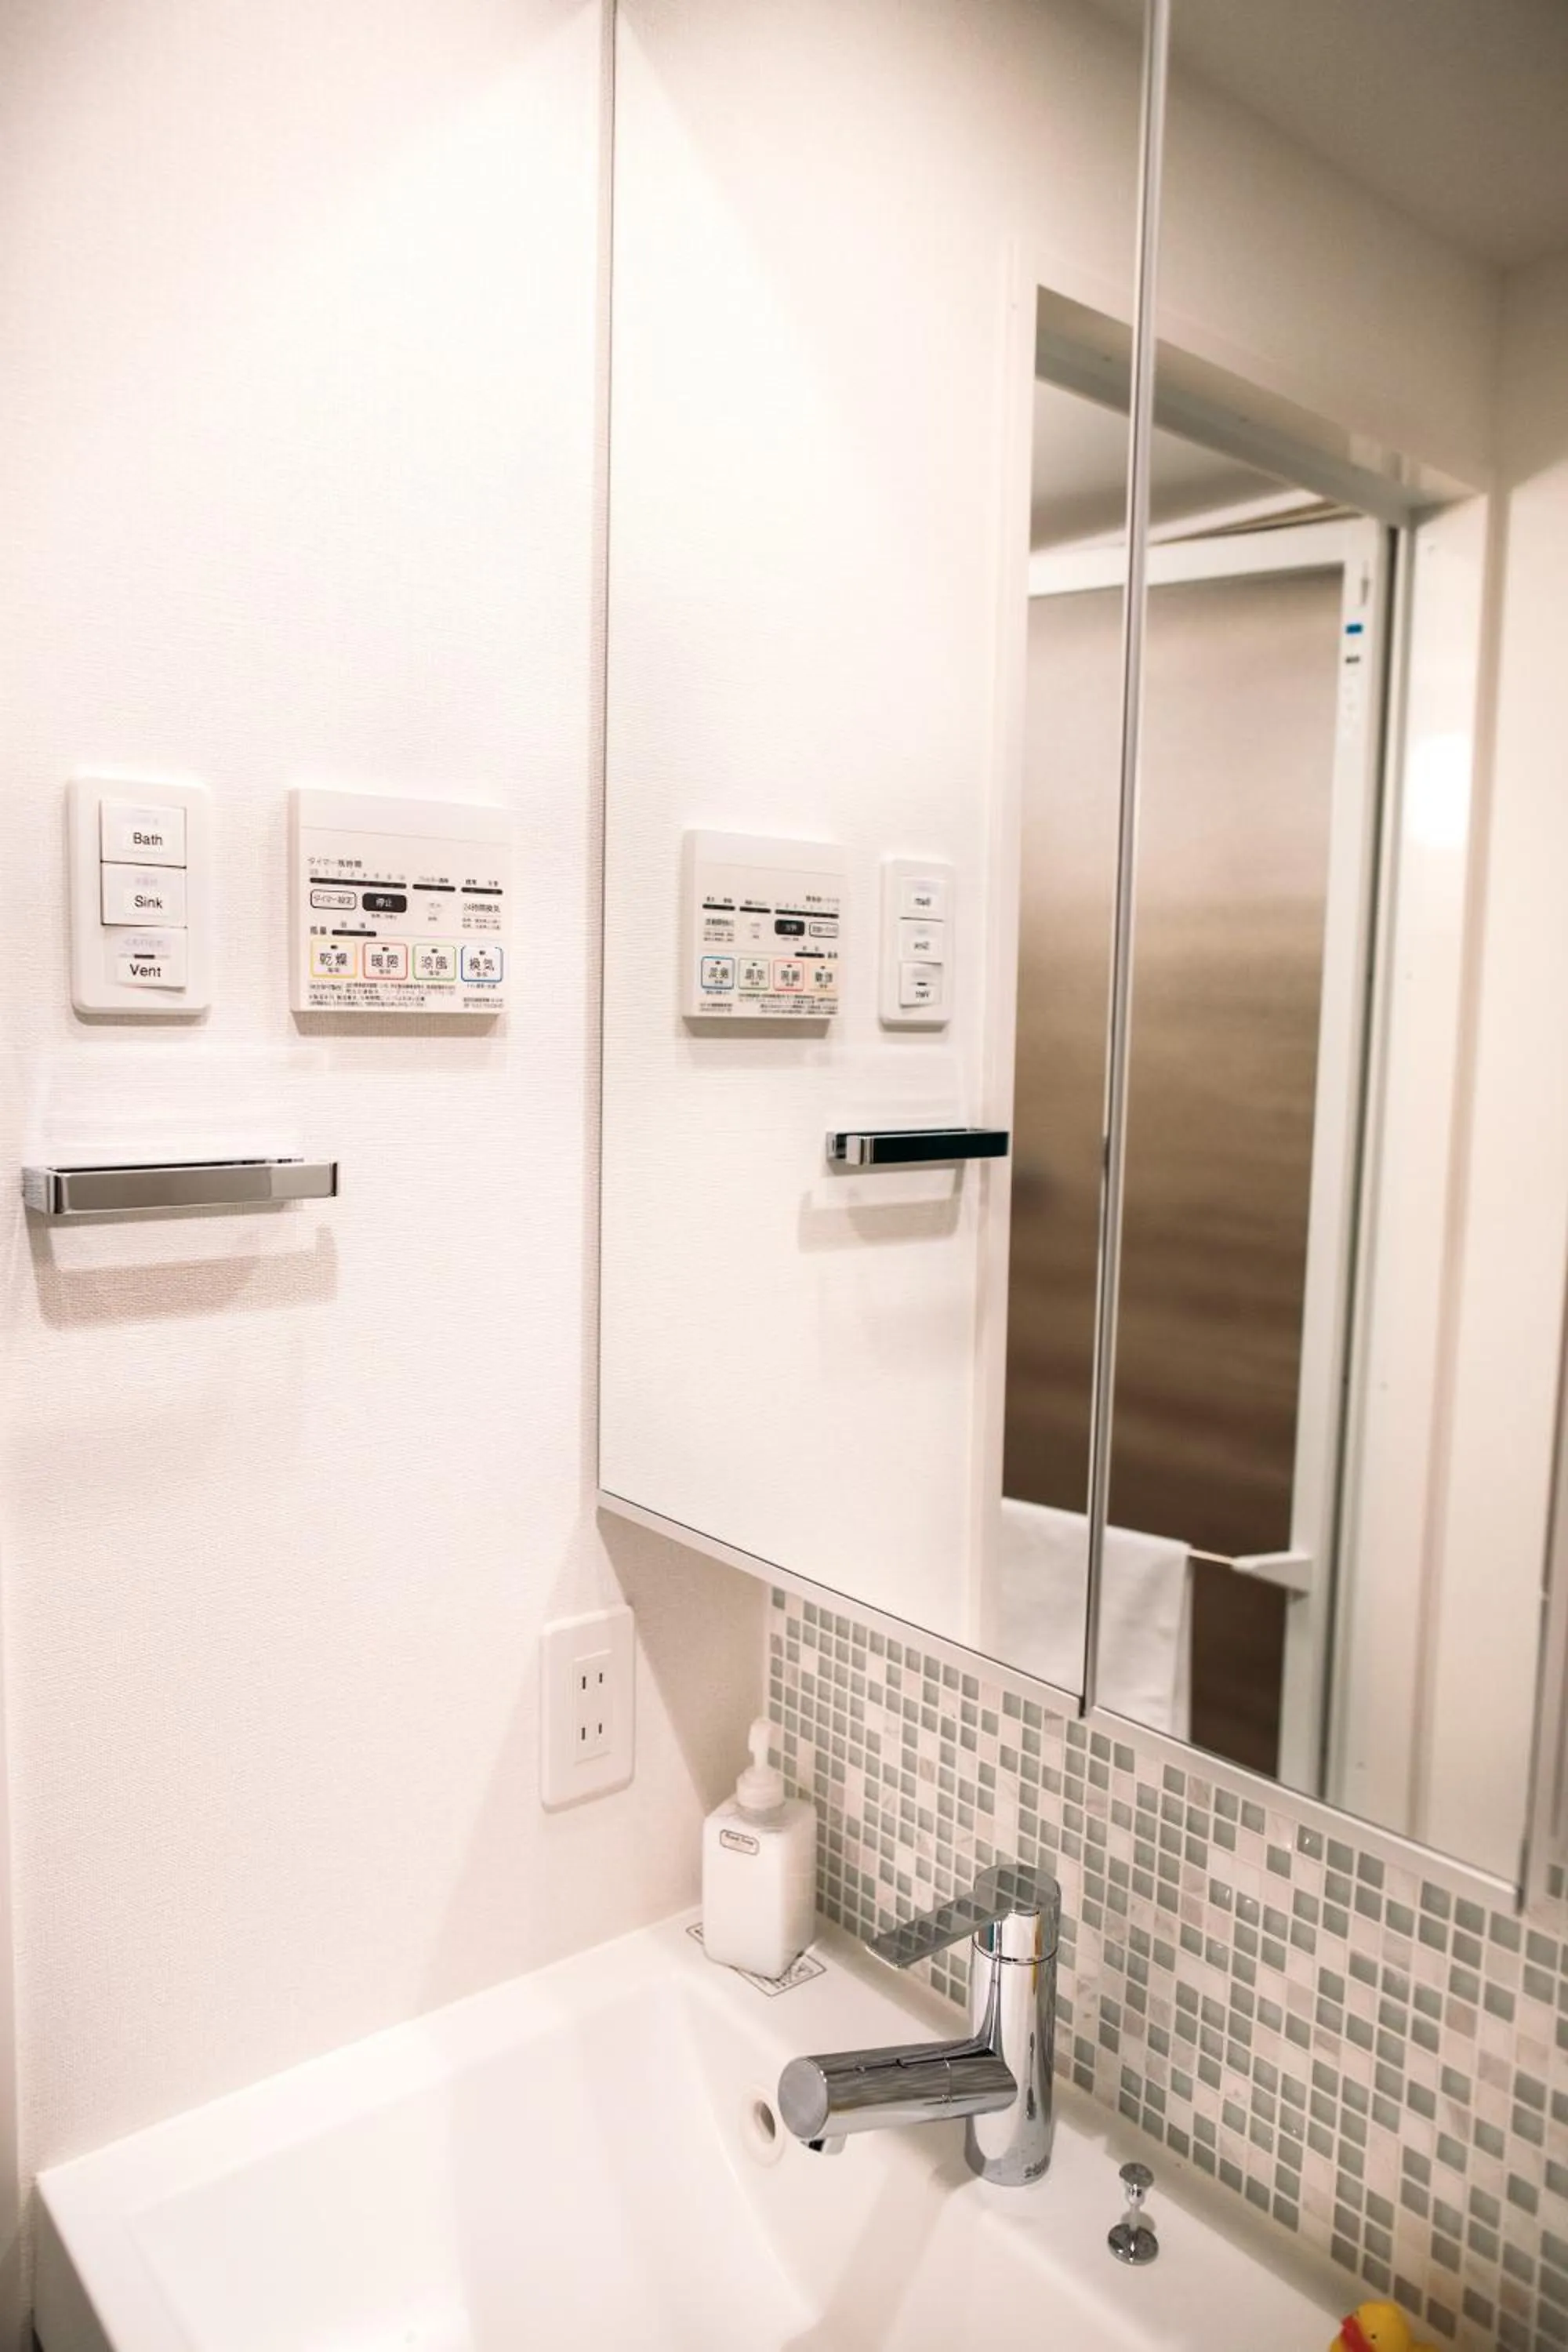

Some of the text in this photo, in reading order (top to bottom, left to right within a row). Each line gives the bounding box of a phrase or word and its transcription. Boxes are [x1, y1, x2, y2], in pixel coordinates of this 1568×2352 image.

[132, 832, 163, 846] Bath
[134, 895, 163, 909] Sink
[375, 897, 393, 907] 停止
[319, 953, 347, 967] 乾燥
[371, 953, 399, 968] 暖房
[420, 956, 448, 970] 涼風
[469, 956, 495, 971] 換気
[129, 963, 162, 978] Vent
